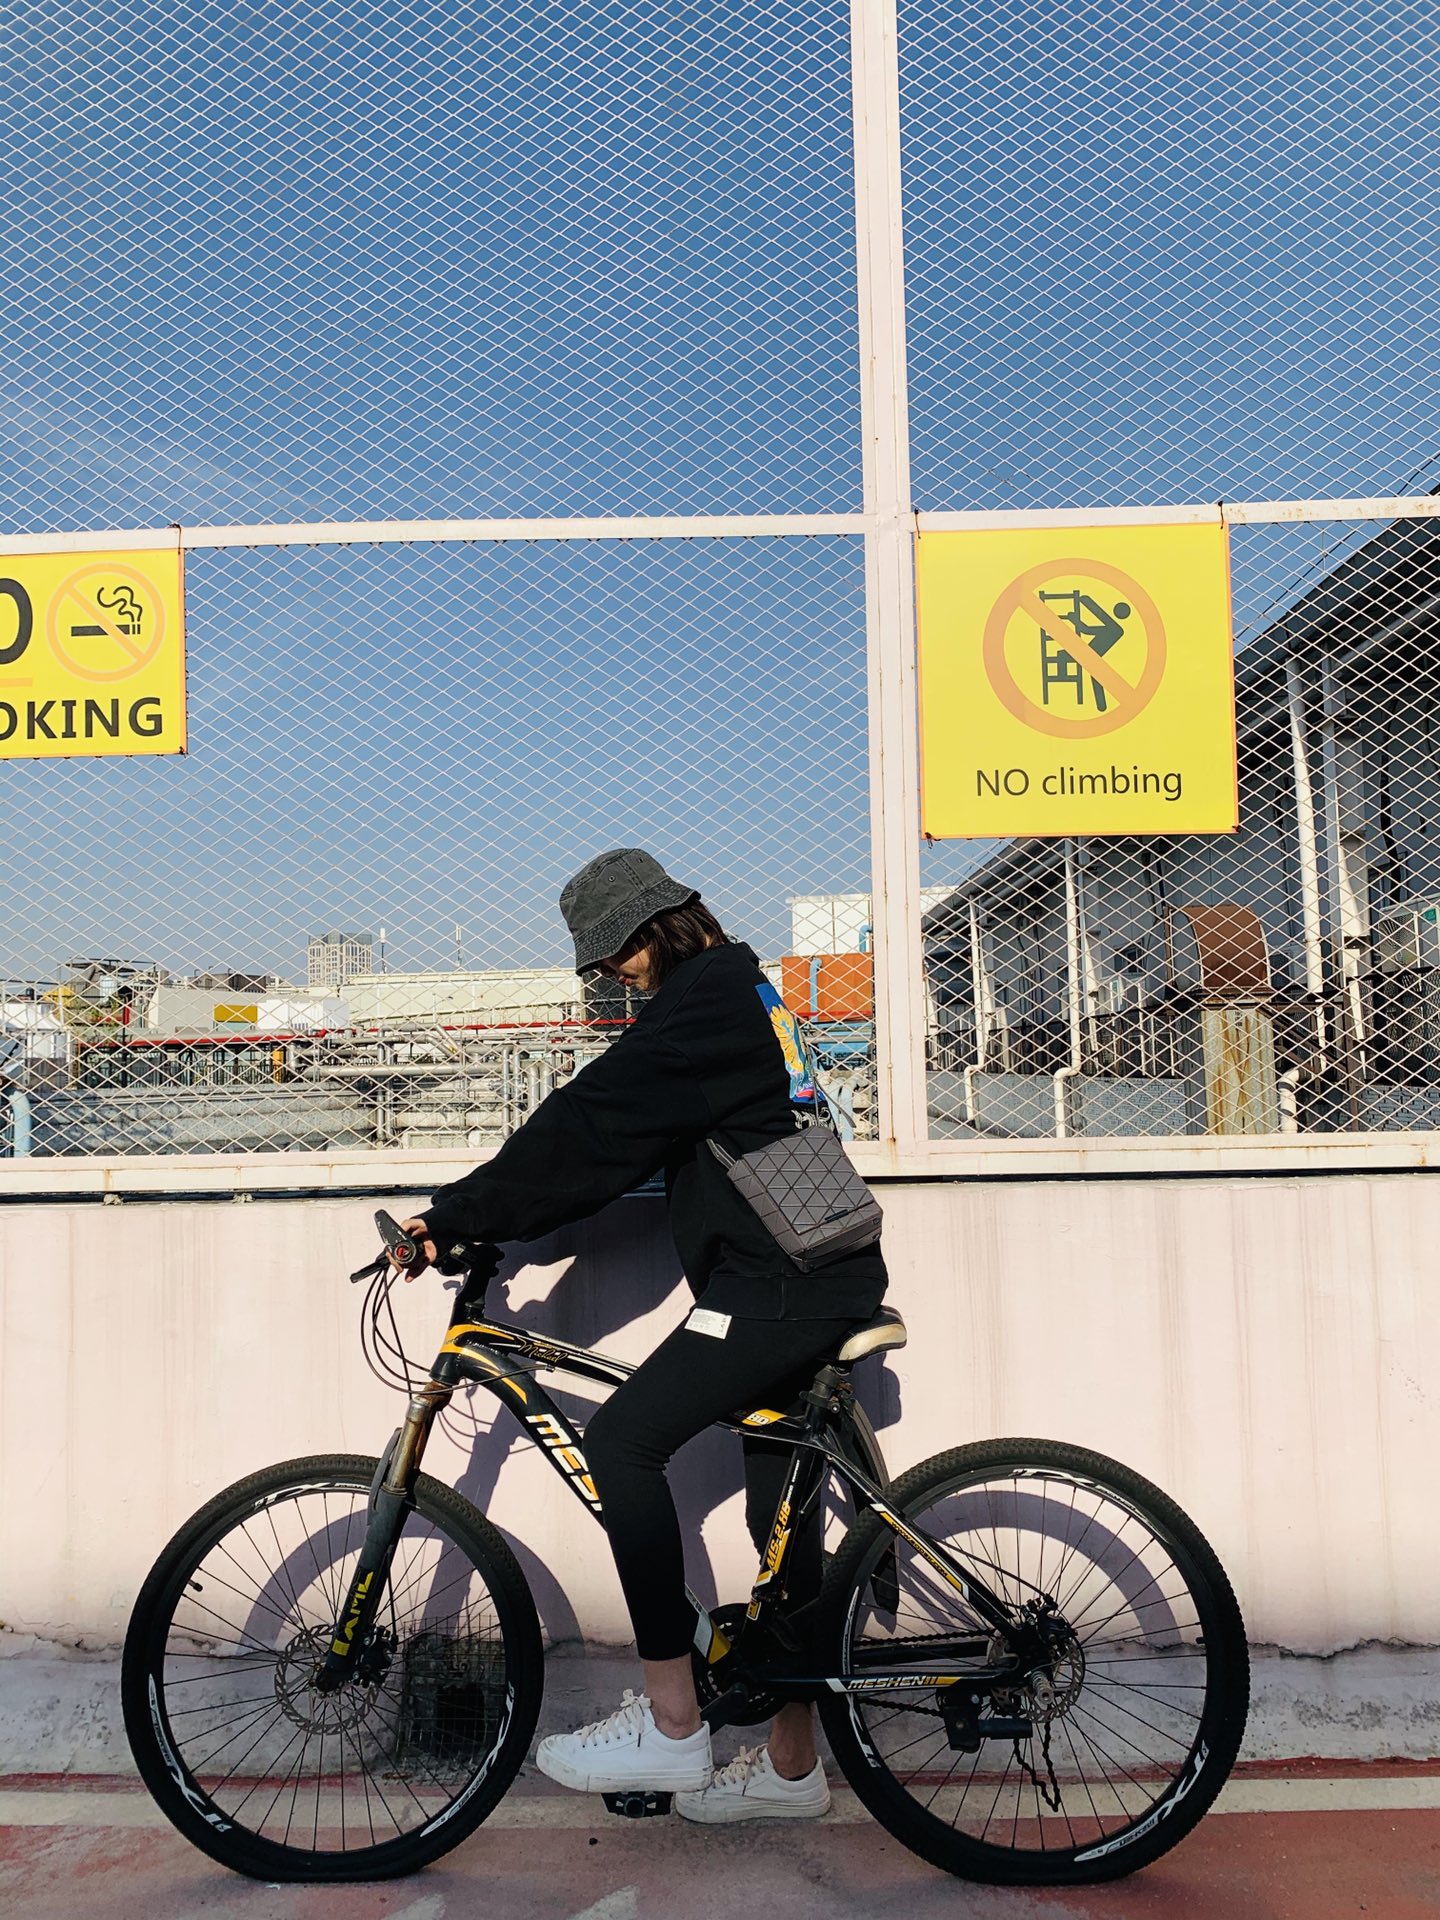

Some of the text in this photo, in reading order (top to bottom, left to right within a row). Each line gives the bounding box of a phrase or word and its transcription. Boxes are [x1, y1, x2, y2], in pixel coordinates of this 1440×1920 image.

[976, 765, 1182, 801] NO climbing
[525, 1413, 603, 1512] MES
